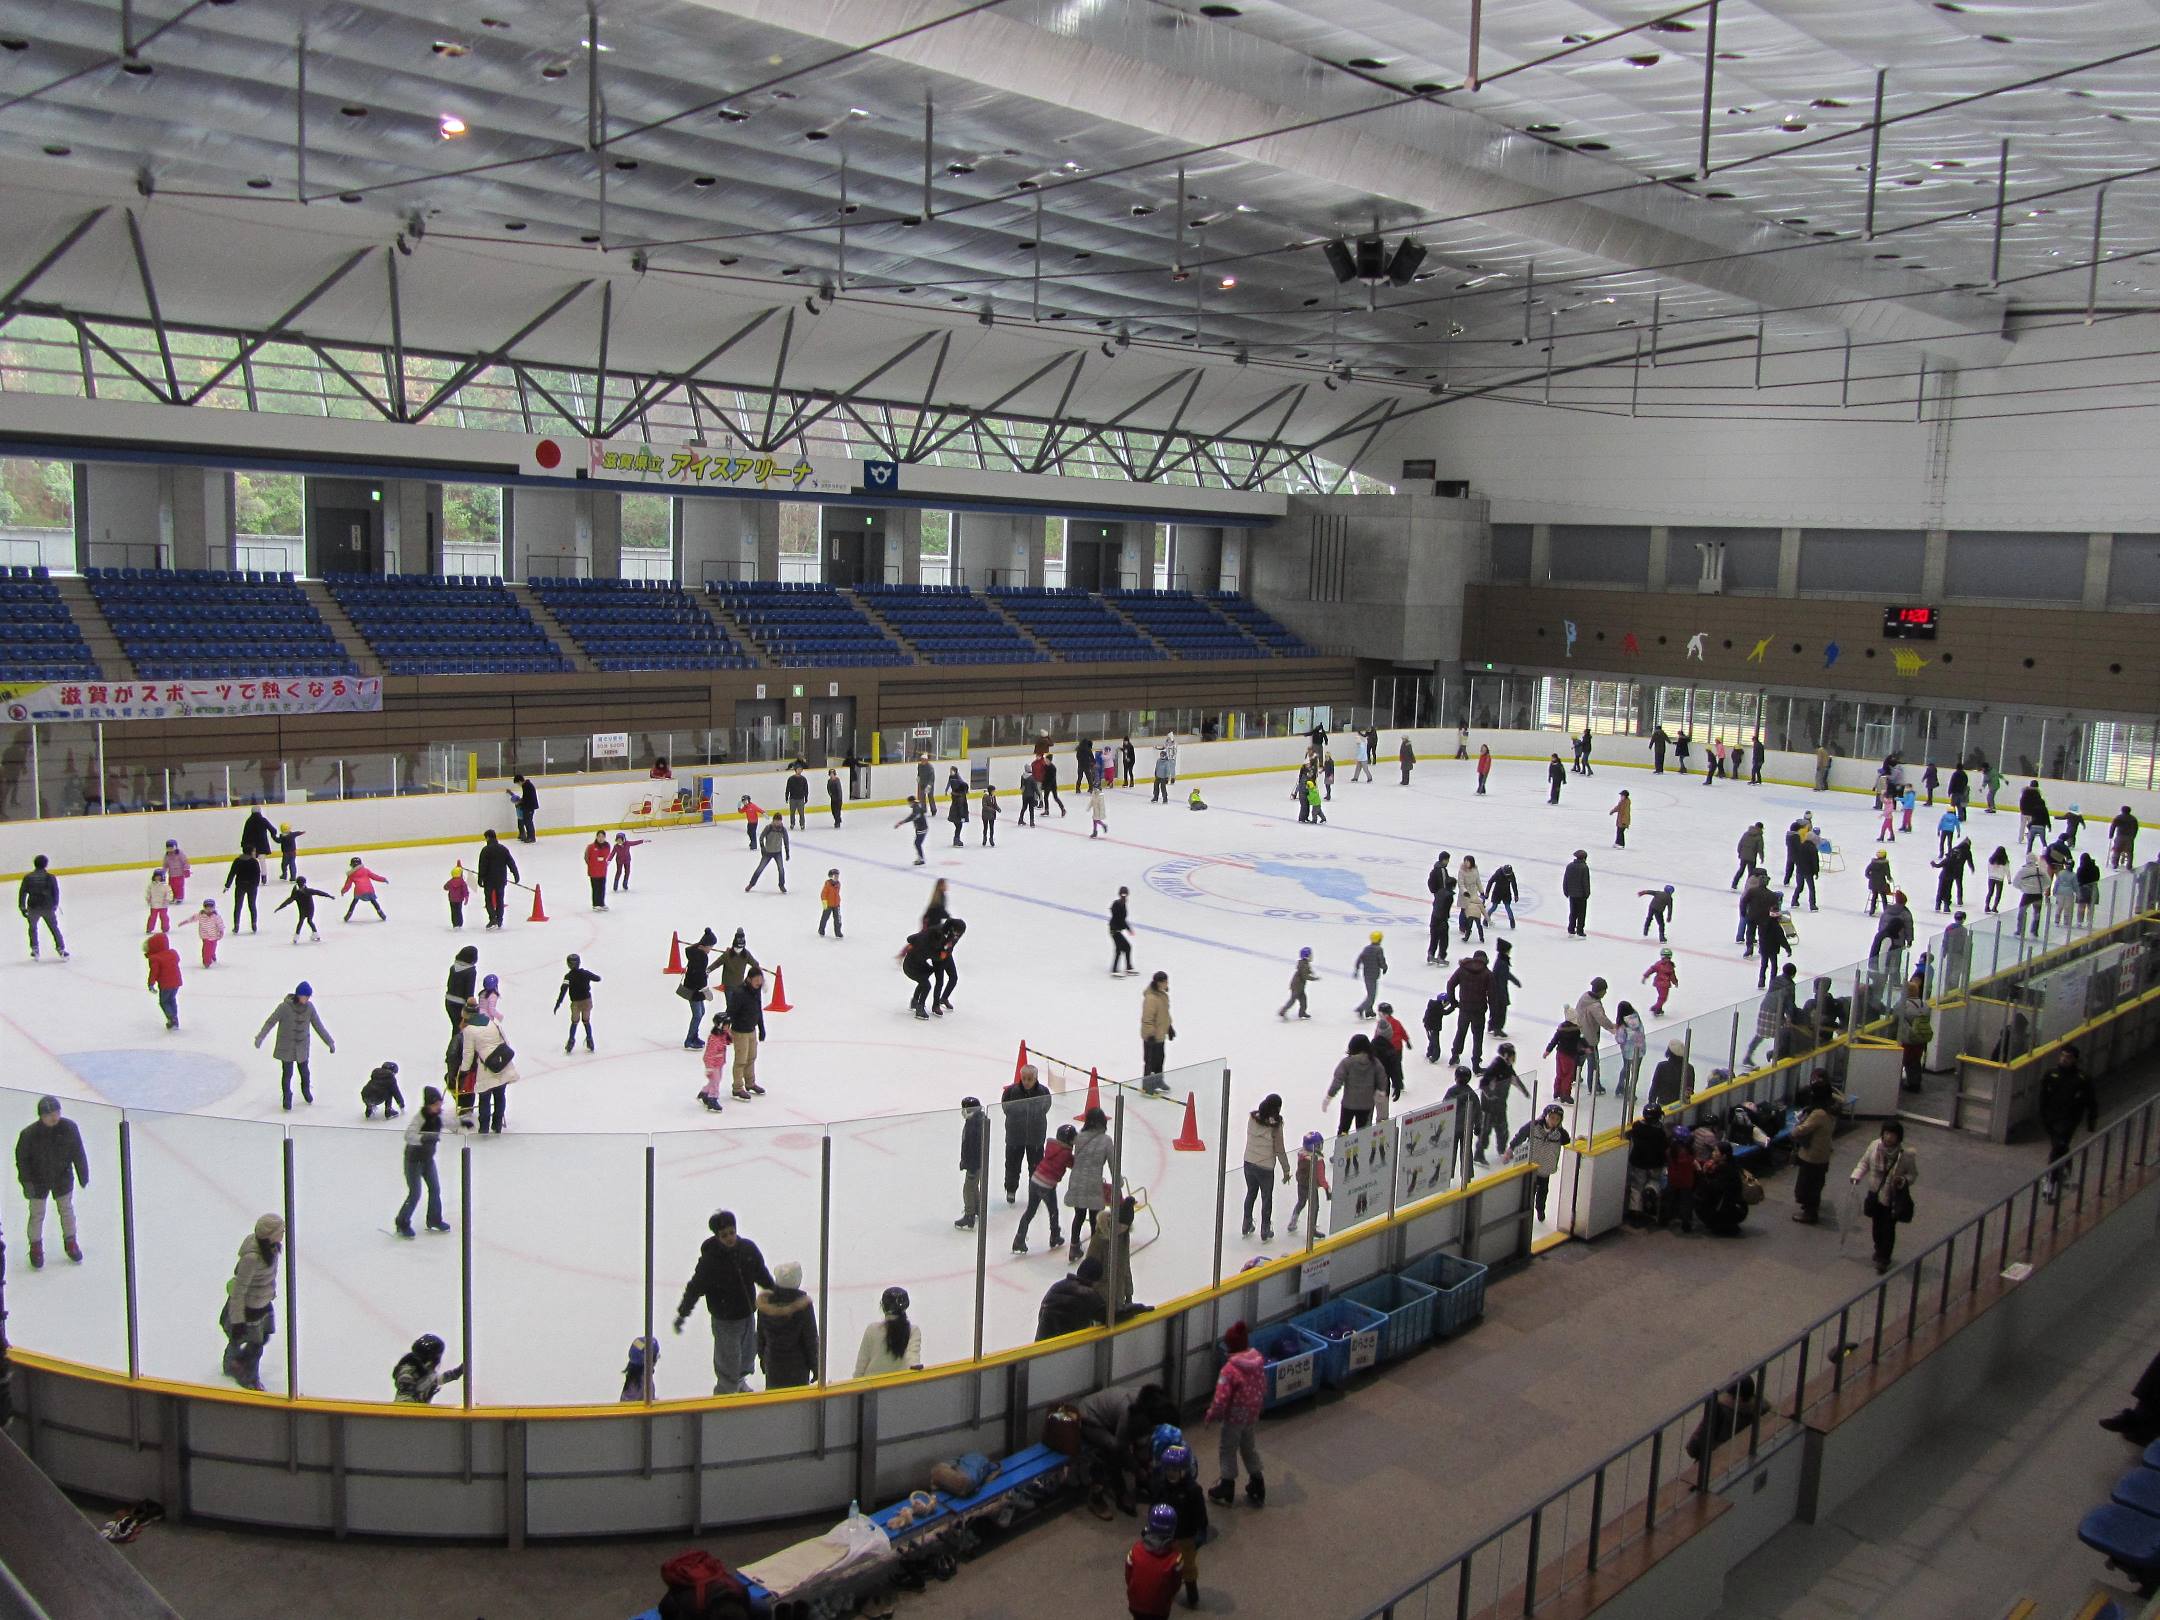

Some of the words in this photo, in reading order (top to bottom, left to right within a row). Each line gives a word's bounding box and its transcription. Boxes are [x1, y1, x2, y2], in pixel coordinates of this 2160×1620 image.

[602, 451, 664, 473] 滋賀県立
[667, 453, 814, 485] アイスアリーナ
[1263, 909, 1321, 920] GO
[1343, 915, 1425, 925] FOR
